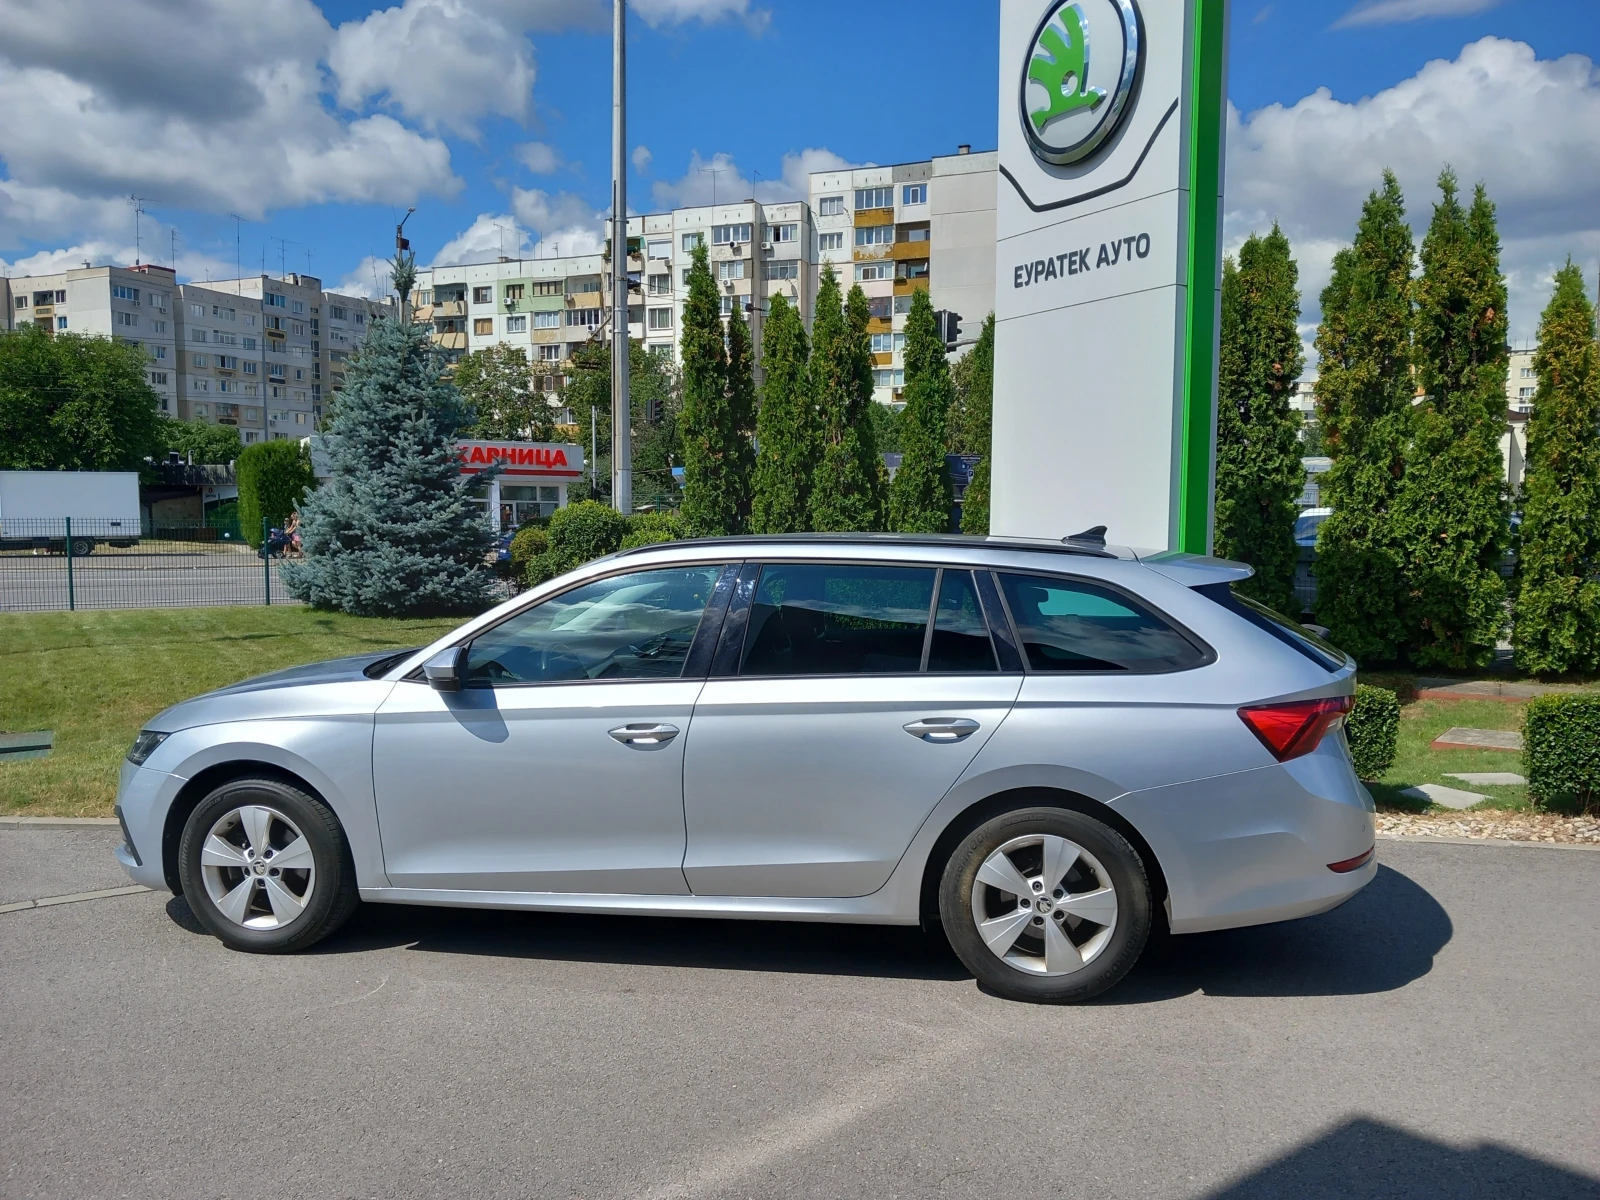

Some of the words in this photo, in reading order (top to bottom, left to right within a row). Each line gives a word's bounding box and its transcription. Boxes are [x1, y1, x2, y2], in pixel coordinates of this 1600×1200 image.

[1014, 247, 1091, 288] ЕУРАТЕК
[1096, 233, 1151, 269] АУТО
[447, 446, 568, 468] КАРНИЦА
